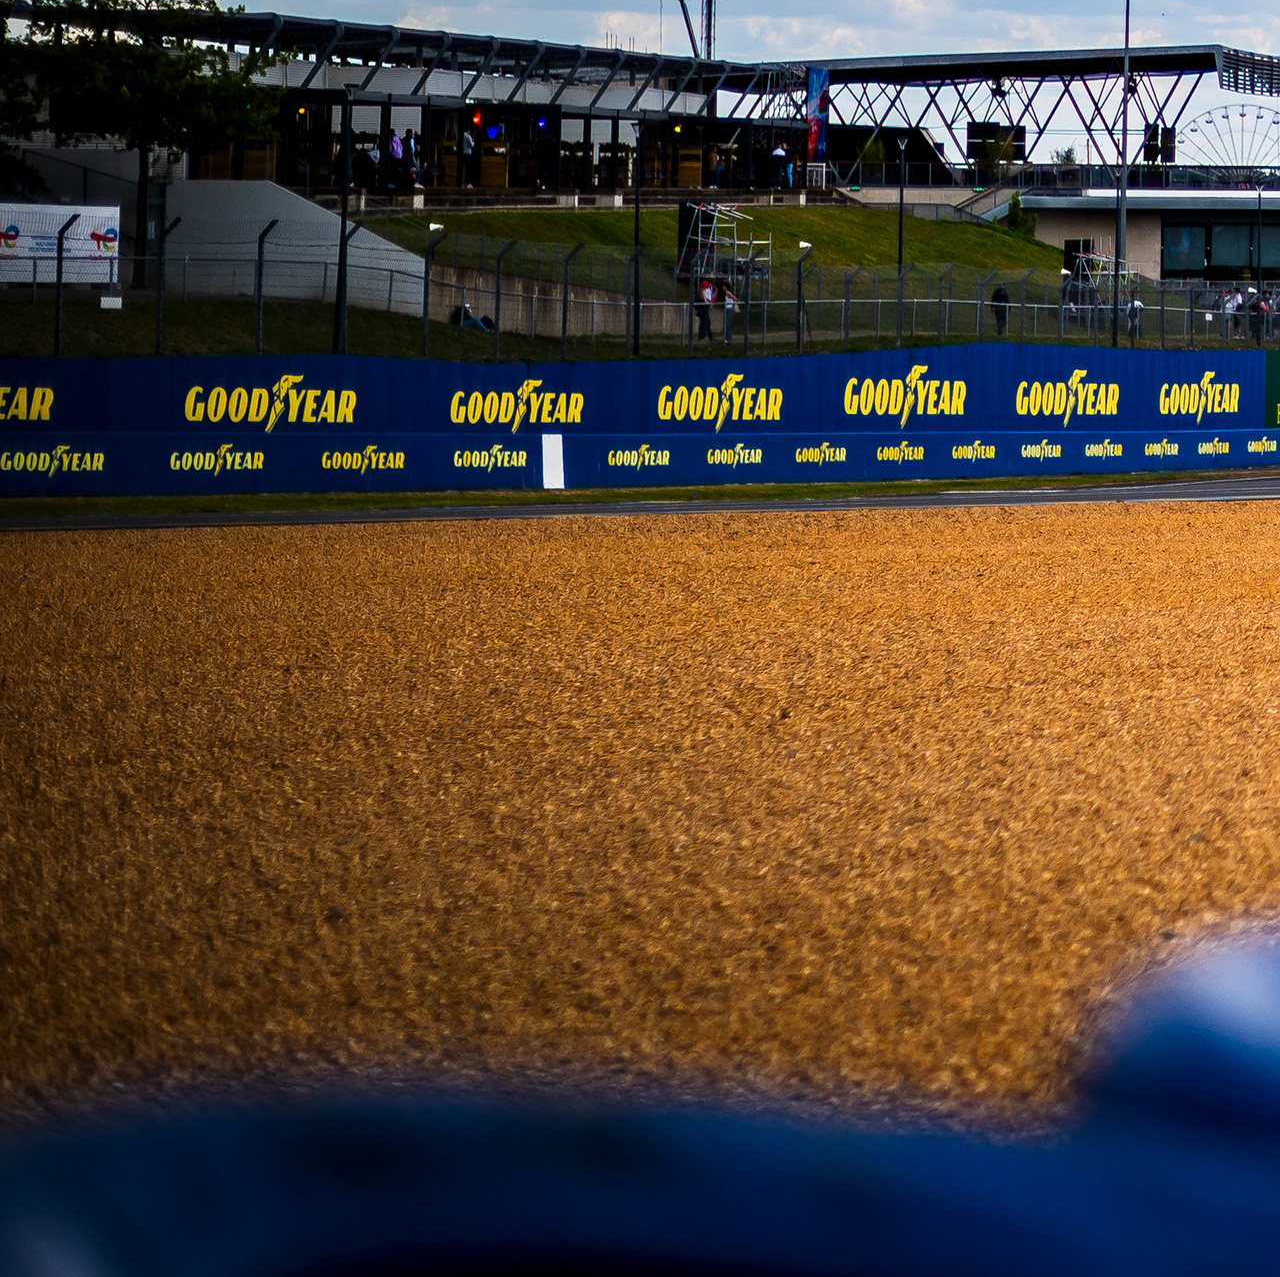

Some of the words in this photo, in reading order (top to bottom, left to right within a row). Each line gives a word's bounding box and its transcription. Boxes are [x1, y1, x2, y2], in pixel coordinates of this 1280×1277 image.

[185, 381, 356, 427] GOODYEAR
[451, 386, 583, 428] GOODYEAR
[658, 380, 782, 426] GOODYEAR
[844, 372, 966, 421] GOODYEAR
[1016, 376, 1119, 420] GOODYEAR
[1160, 378, 1239, 418] GOODYEAR
[1, 450, 104, 473] GOODYEAR
[171, 448, 264, 472] GOODYEAR
[322, 449, 404, 471] GOODYEAR
[454, 448, 526, 469] GOODYEAR
[608, 447, 669, 467] GOODYEAR
[707, 446, 762, 466] GOODYEAR
[796, 445, 846, 464] GOODYEAR
[877, 444, 924, 462] GOODYEAR
[952, 443, 995, 460] GOODYEAR
[1022, 442, 1061, 459] GOODYEAR
